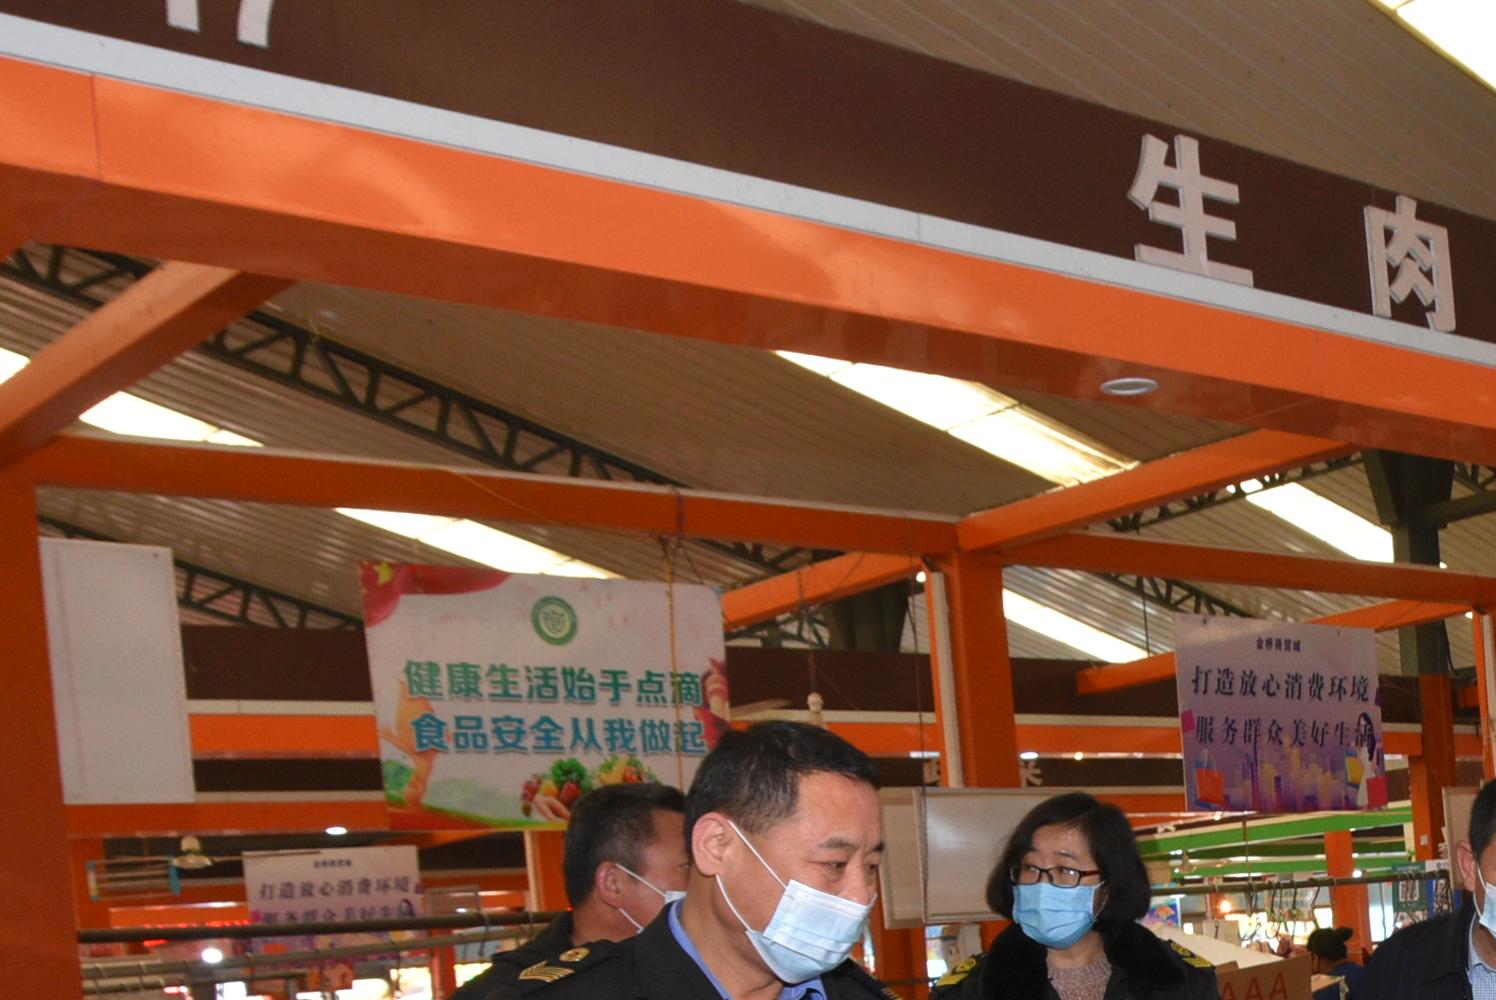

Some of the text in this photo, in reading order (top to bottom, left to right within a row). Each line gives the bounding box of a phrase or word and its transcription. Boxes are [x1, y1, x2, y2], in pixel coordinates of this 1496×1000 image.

[1127, 133, 1456, 332] 生肉
[404, 659, 703, 706] 健康生活始于点滴
[1191, 665, 1370, 702] 打造放心消费环境
[410, 713, 706, 755] 食品安全从我做起
[1195, 715, 1374, 749] 服务群众美好生活
